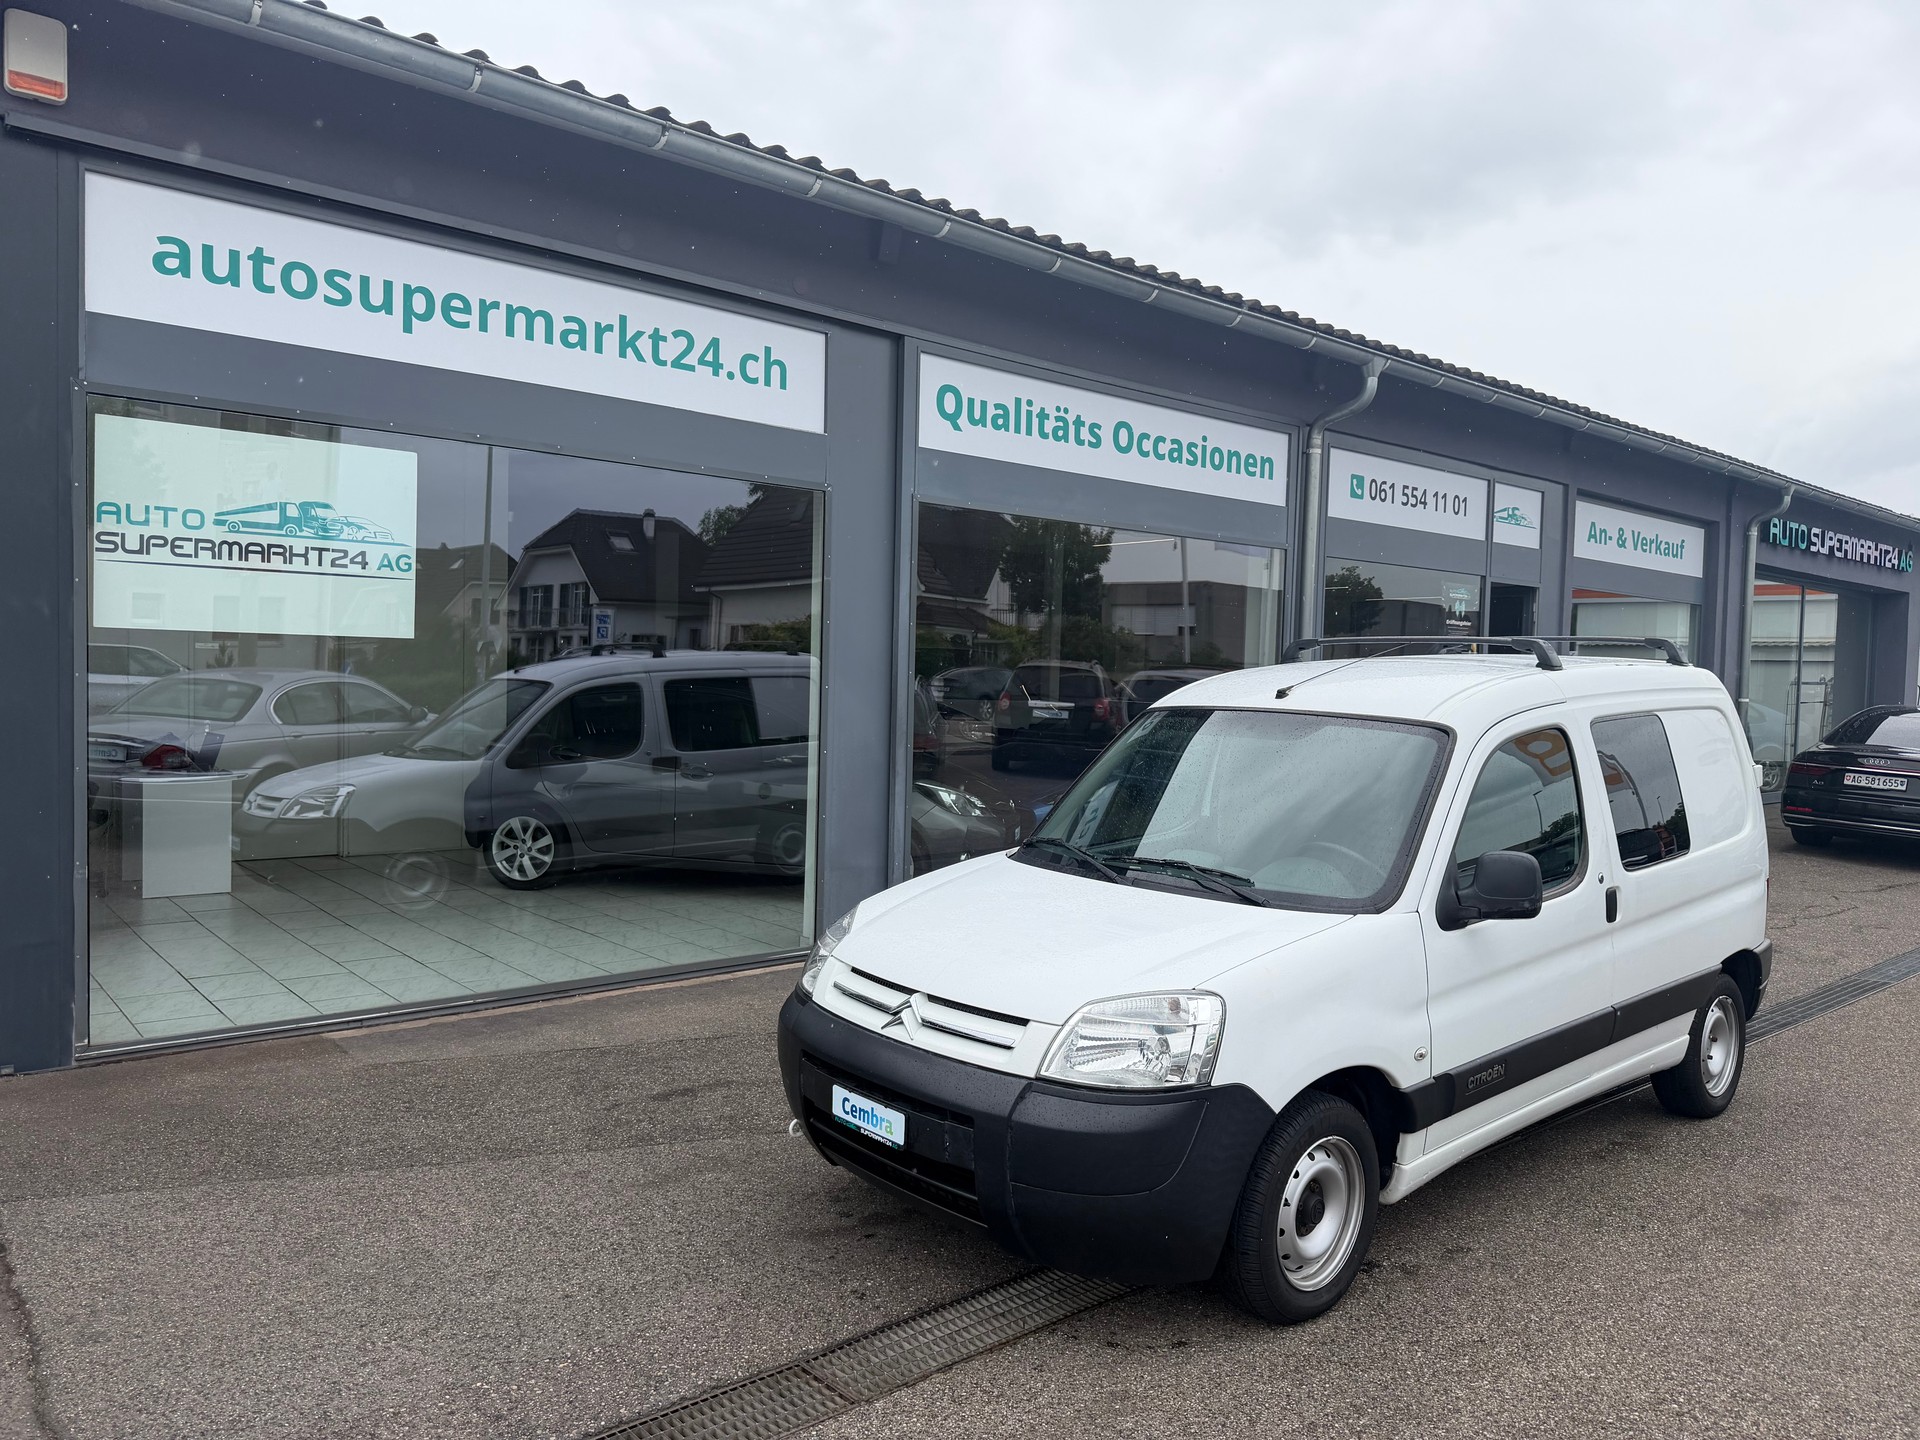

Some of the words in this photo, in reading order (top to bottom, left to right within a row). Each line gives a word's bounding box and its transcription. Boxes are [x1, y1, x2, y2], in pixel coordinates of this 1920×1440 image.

[151, 234, 789, 392] autosupermarkt24.ch
[935, 383, 1103, 450] Qualitäts
[1112, 420, 1275, 481] Occasionen
[95, 500, 206, 530] AUTO
[1369, 478, 1395, 504] 061
[1401, 484, 1428, 510] 554
[1432, 490, 1448, 514] 11
[1452, 494, 1468, 517] 01
[95, 530, 368, 570] SUPERMARKT24
[376, 552, 413, 573] AG
[1586, 520, 1613, 546] An-
[1616, 526, 1628, 550] &
[1631, 529, 1686, 560] Verkauf
[1769, 517, 1808, 550] AUTO
[1810, 527, 1899, 570] SUPERMARKT24
[1899, 548, 1914, 573] AG
[1467, 1064, 1505, 1089] CITROËN
[842, 1096, 894, 1136] Cembra
